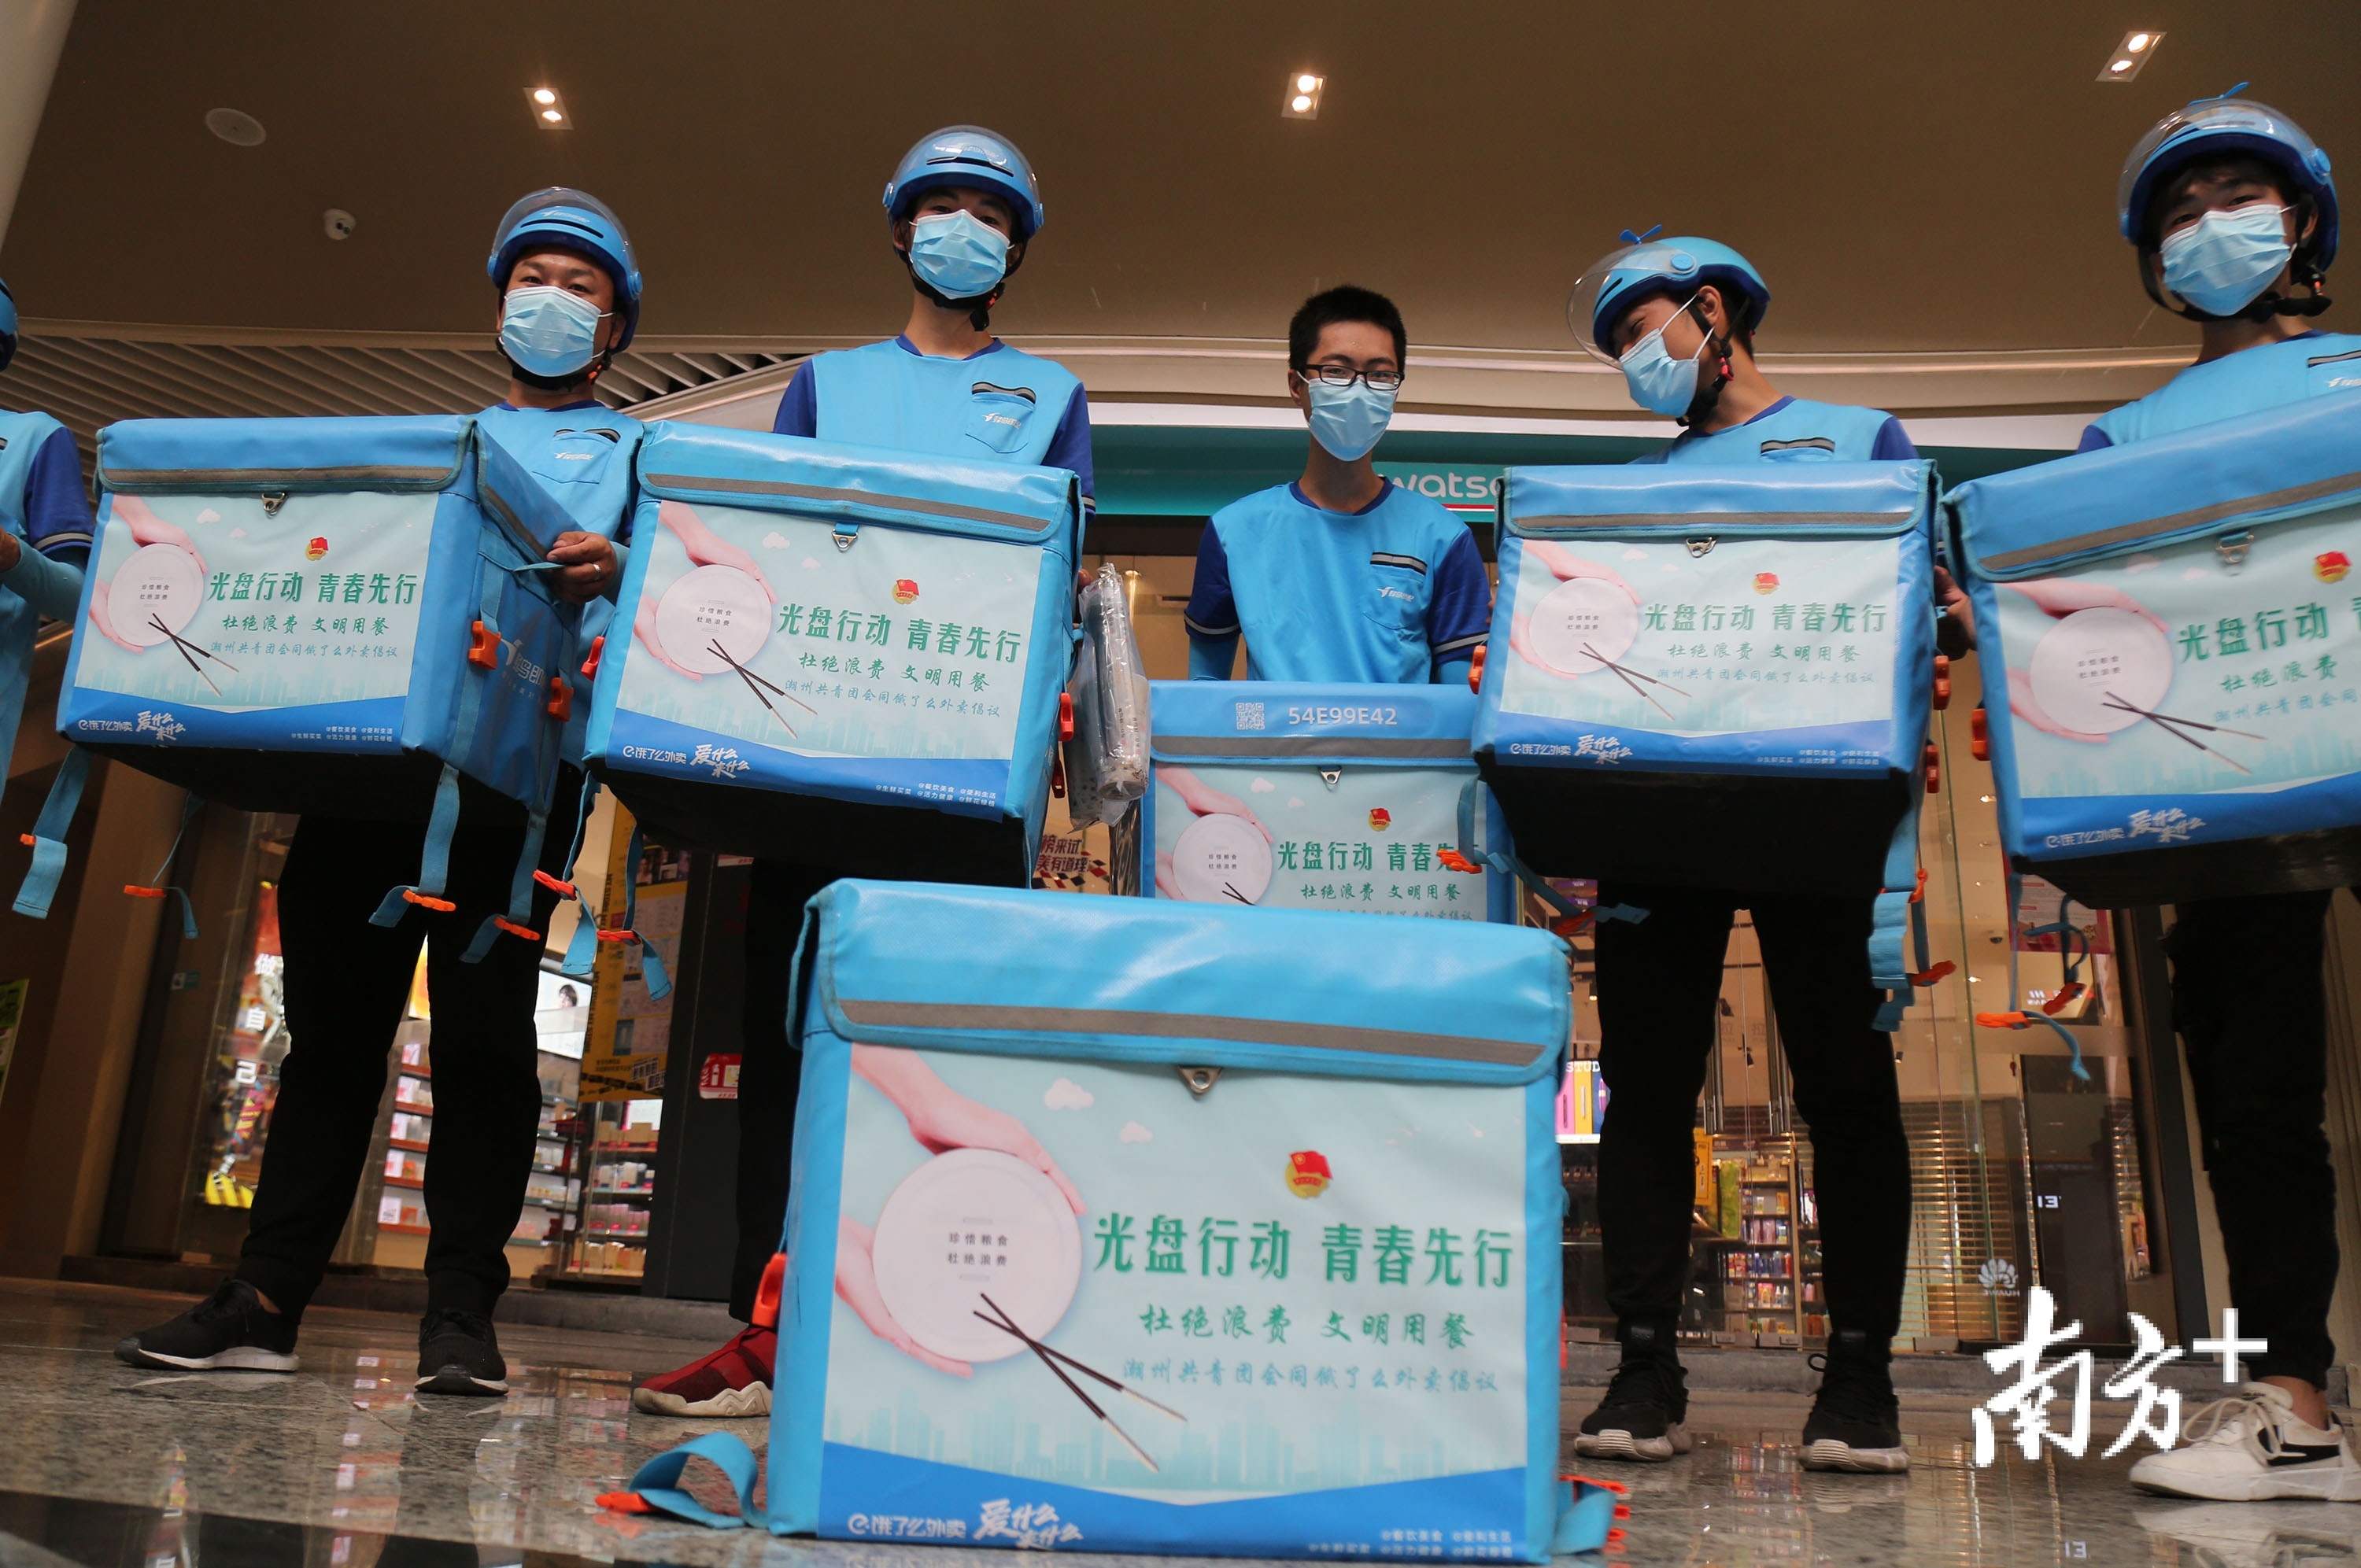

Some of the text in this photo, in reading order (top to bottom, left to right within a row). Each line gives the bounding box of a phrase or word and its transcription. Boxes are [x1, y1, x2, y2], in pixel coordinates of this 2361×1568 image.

[1379, 472, 1498, 498] ats
[206, 571, 417, 606] 光盘行动 青春先行
[222, 614, 390, 636] 杜绝浪费 文明用餐
[776, 603, 1022, 663] 光盘行动 青春先行
[1644, 603, 1886, 633] 光盘行动 青春先行
[2178, 601, 2330, 664] 光盘行动
[1668, 641, 1861, 662] 杜绝浪费 文明用餐
[798, 651, 991, 693] 杜绝浪费 文明用餐
[2220, 654, 2338, 694] 杜绝浪费
[785, 678, 1001, 718] 潮州共青团会同饿了么外卖倡议
[1288, 707, 1398, 725] 54E99E42
[635, 747, 687, 765] 饿了么外卖
[1522, 743, 1572, 756] 饿了么外卖
[1277, 841, 1478, 872] 光盘行动 青春
[1300, 883, 1461, 902] 杜绝浪费 文明用餐
[1093, 1212, 1514, 1288] 光盘行动 青春先行
[1140, 1304, 1475, 1349] 杜绝浪费 文明用餐
[1123, 1359, 1499, 1393] 潮州共青团会同饿了么外卖倡议
[871, 1515, 966, 1539] 饿了么外卖
